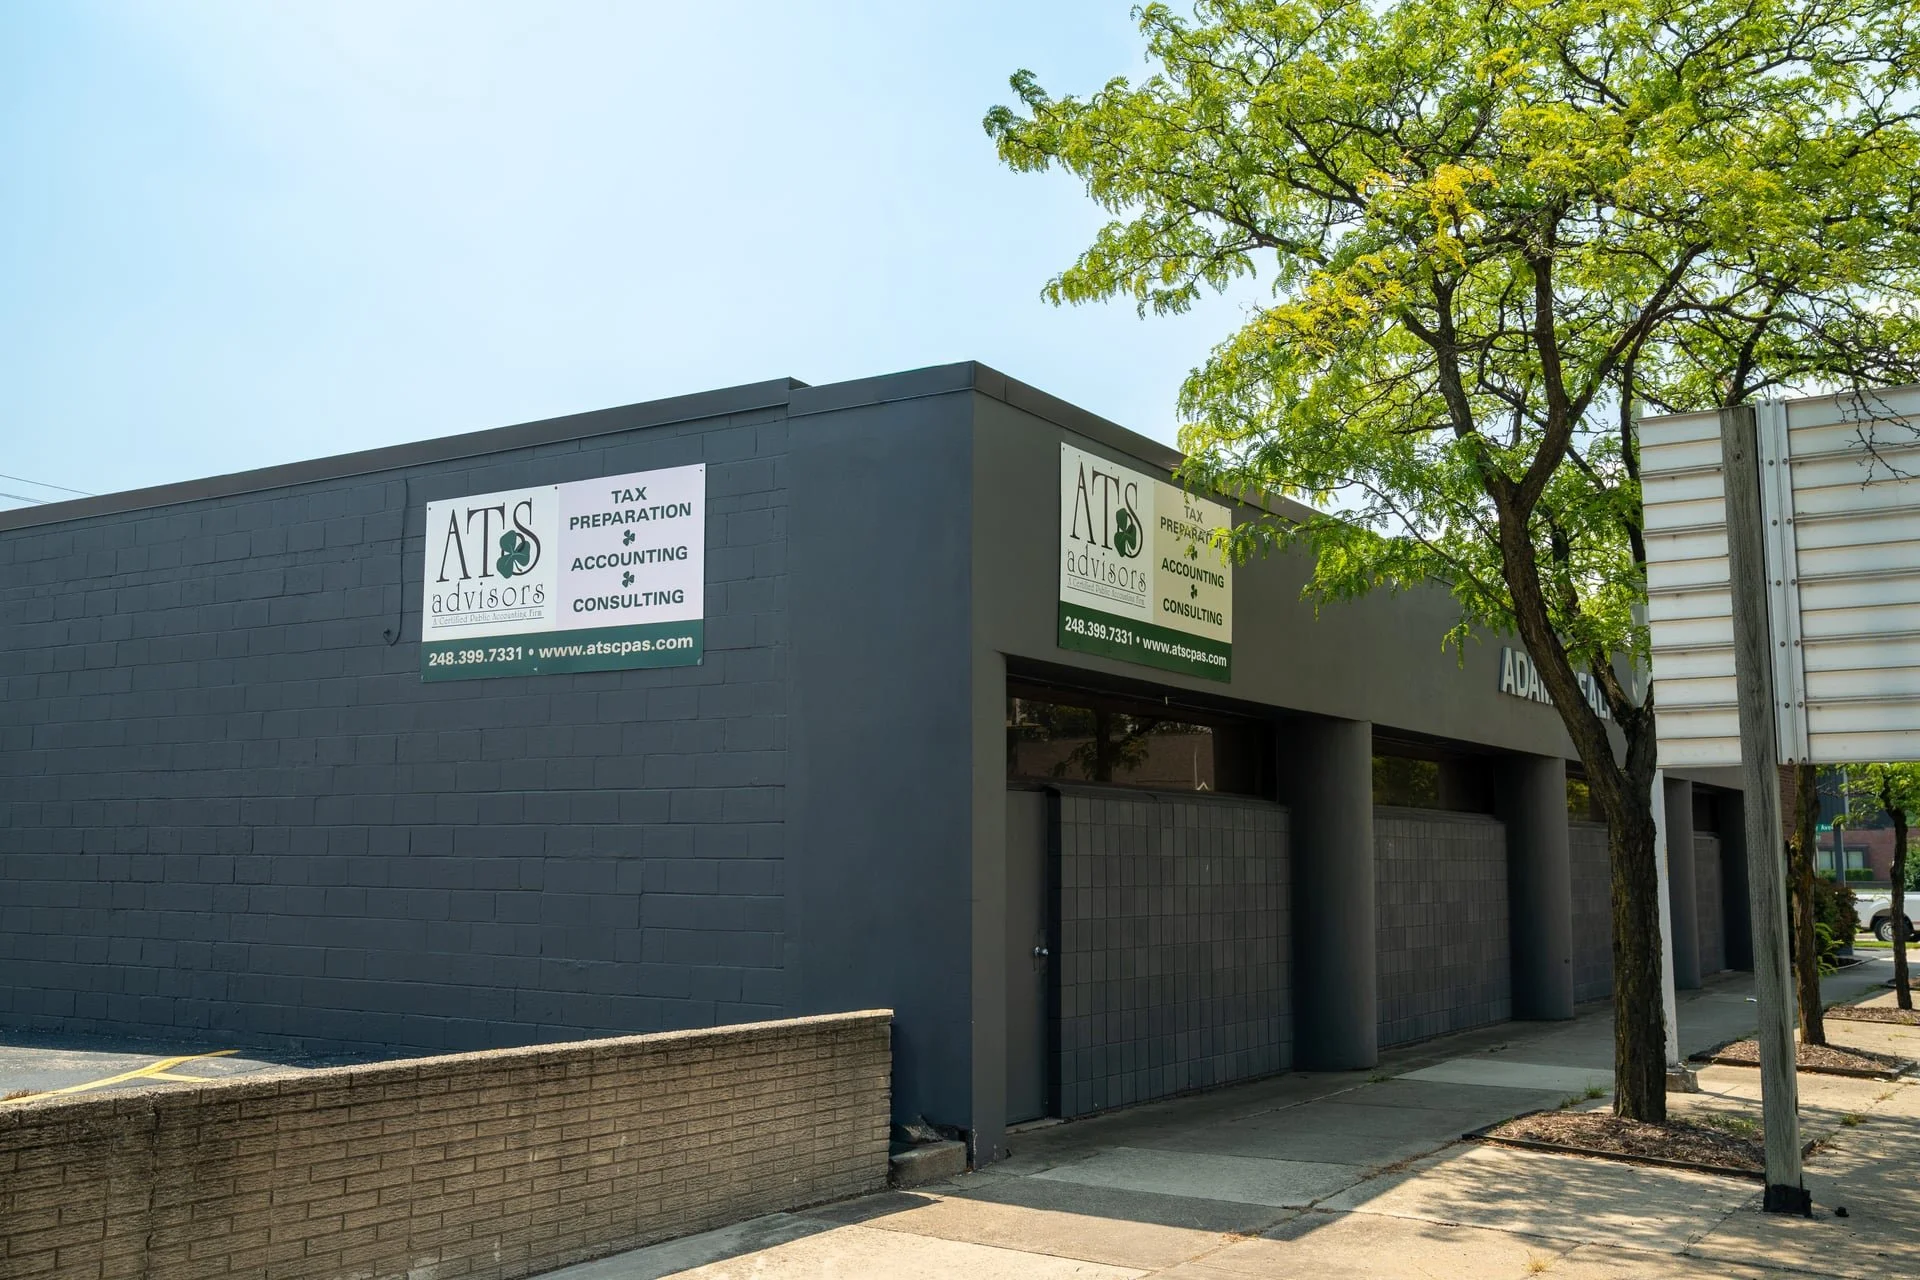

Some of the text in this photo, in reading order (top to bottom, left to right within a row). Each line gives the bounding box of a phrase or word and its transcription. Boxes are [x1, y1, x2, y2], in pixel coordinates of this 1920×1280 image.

[611, 486, 648, 504] TAX
[569, 502, 692, 530] PREPARATION
[1069, 461, 1143, 559] ATS
[1184, 505, 1204, 524] TAX
[436, 497, 541, 583] ATS
[570, 545, 688, 571] ACCOUNTING
[1067, 544, 1147, 593] advisors
[1161, 557, 1225, 588] ACCOUNTING
[431, 581, 545, 613] advisors
[572, 589, 685, 612] CONSULTING
[439, 615, 468, 625] Certified
[470, 612, 491, 622] Public
[492, 611, 527, 621] Accounting
[529, 608, 543, 618] Firm
[1163, 598, 1223, 626] CONSULTING
[428, 635, 694, 666] 248.399.7331 www.atscpas.com
[1065, 616, 1227, 667] 248.399.7331 www.atscpas.com
